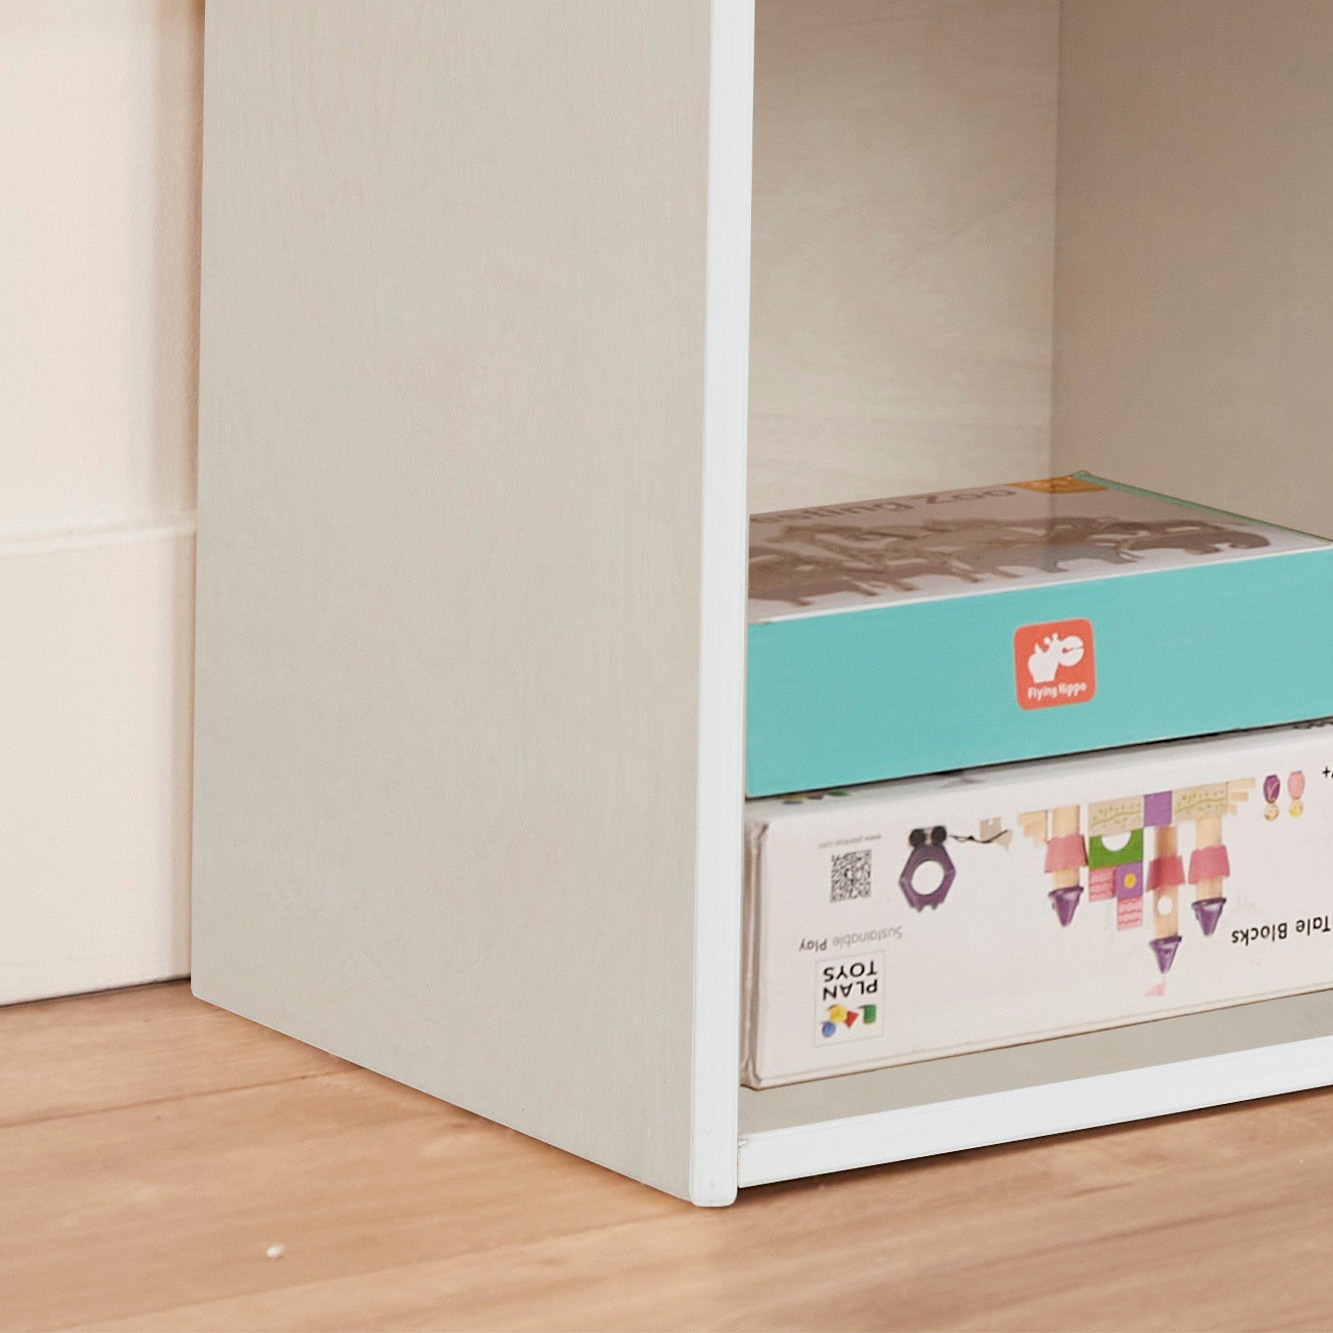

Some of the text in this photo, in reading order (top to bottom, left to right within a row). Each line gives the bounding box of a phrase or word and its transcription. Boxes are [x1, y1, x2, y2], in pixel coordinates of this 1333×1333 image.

[1027, 686, 1058, 701] Flying
[1231, 922, 1287, 946] Blocks
[1295, 915, 1330, 935] Tale
[799, 938, 828, 952] Play
[823, 960, 877, 982] TOYS
[822, 979, 878, 1001] PLAN
